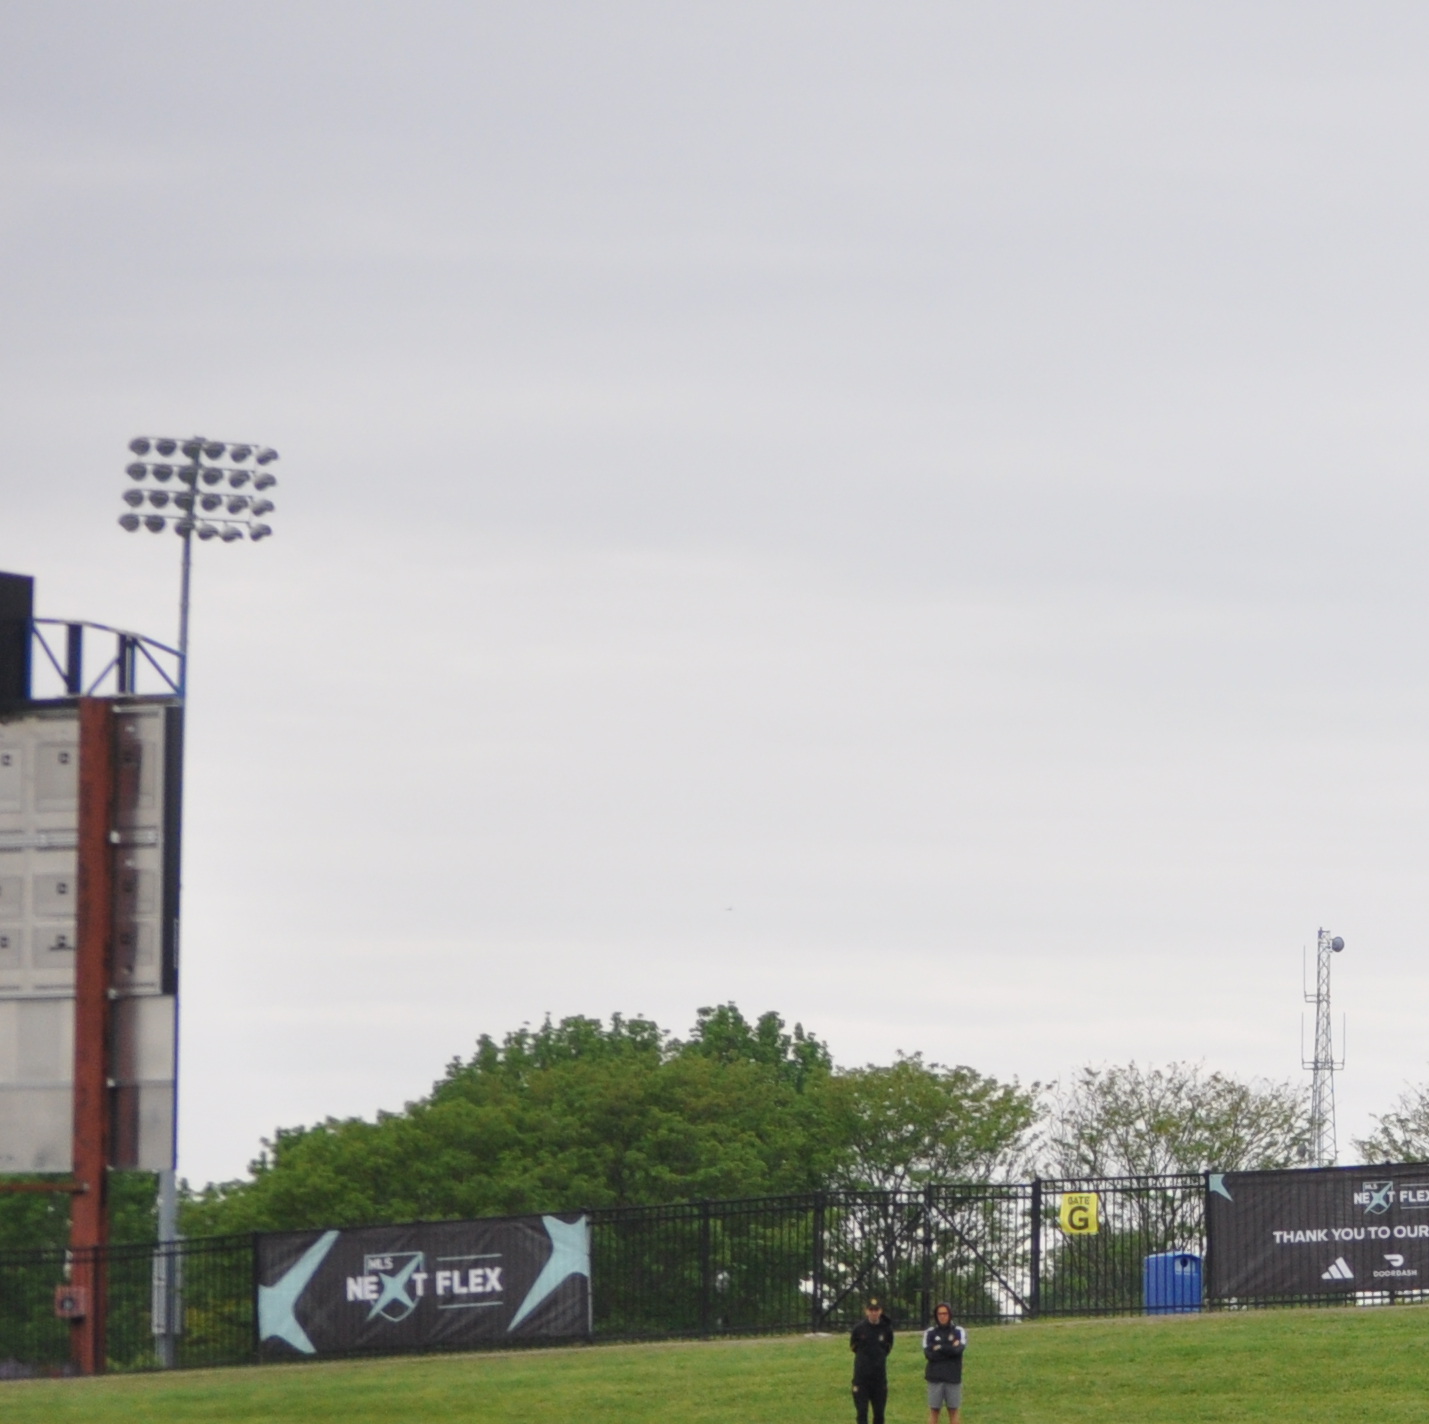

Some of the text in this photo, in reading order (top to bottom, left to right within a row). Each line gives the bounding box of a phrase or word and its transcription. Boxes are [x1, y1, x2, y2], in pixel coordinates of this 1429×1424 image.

[1068, 1196, 1090, 1205] GATE
[1068, 1205, 1089, 1231] G
[1272, 1229, 1328, 1244] THANK
[1331, 1227, 1365, 1241] YOU
[1367, 1226, 1391, 1239] TO
[1393, 1225, 1429, 1238] OUR
[368, 1257, 394, 1270] MLS
[346, 1267, 503, 1307] NEXT FLEX
